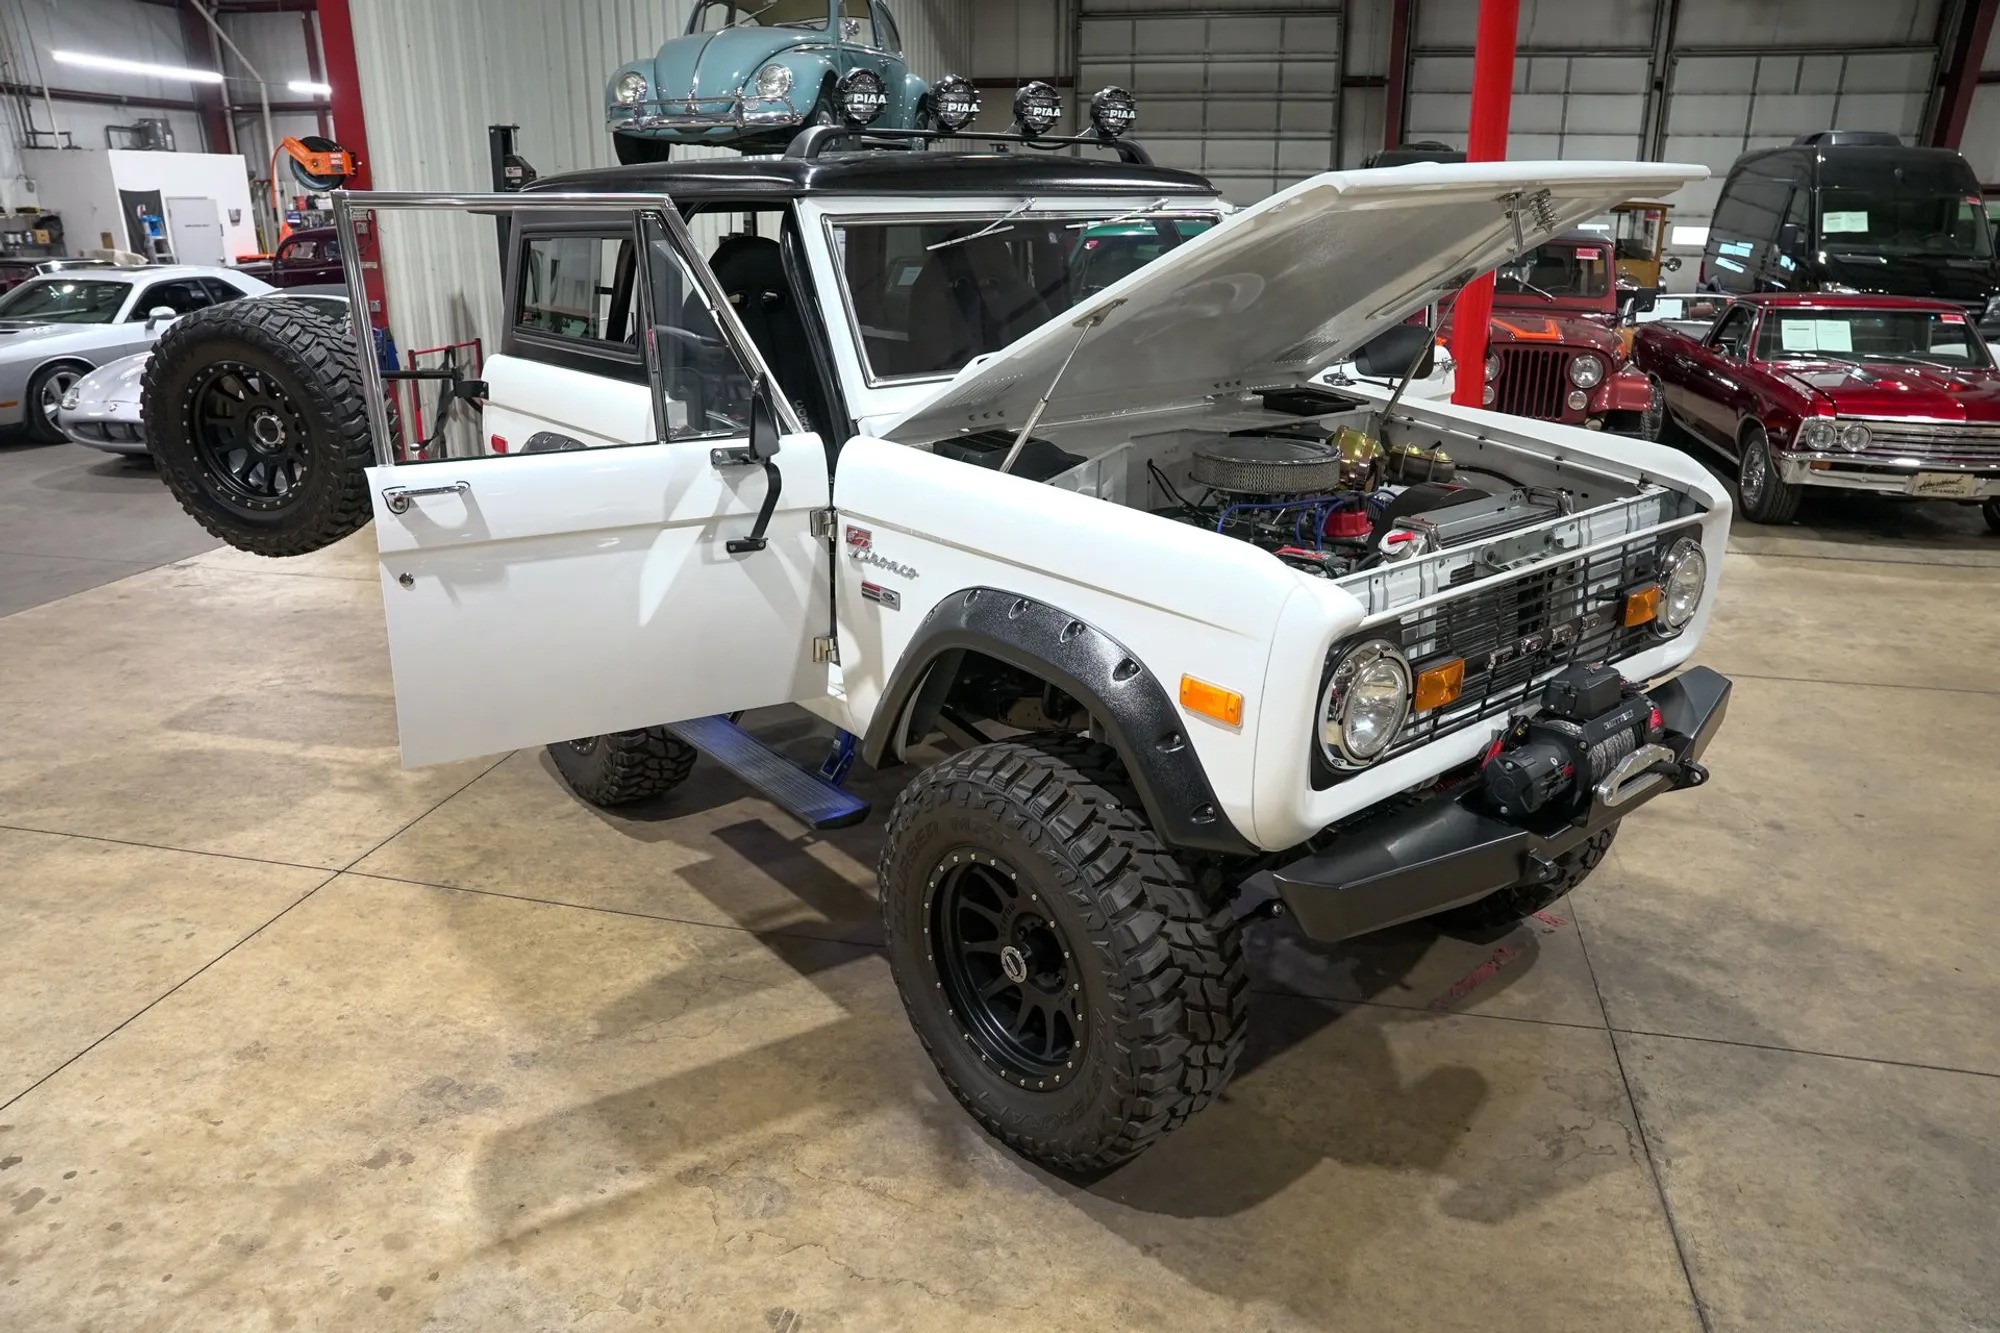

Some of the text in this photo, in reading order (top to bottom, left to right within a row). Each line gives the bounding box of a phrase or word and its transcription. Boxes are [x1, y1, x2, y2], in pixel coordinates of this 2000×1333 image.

[853, 93, 887, 104] PIAA
[947, 102, 980, 113] PIAA
[1033, 106, 1061, 117] PIAA
[1109, 109, 1136, 119] PIAA
